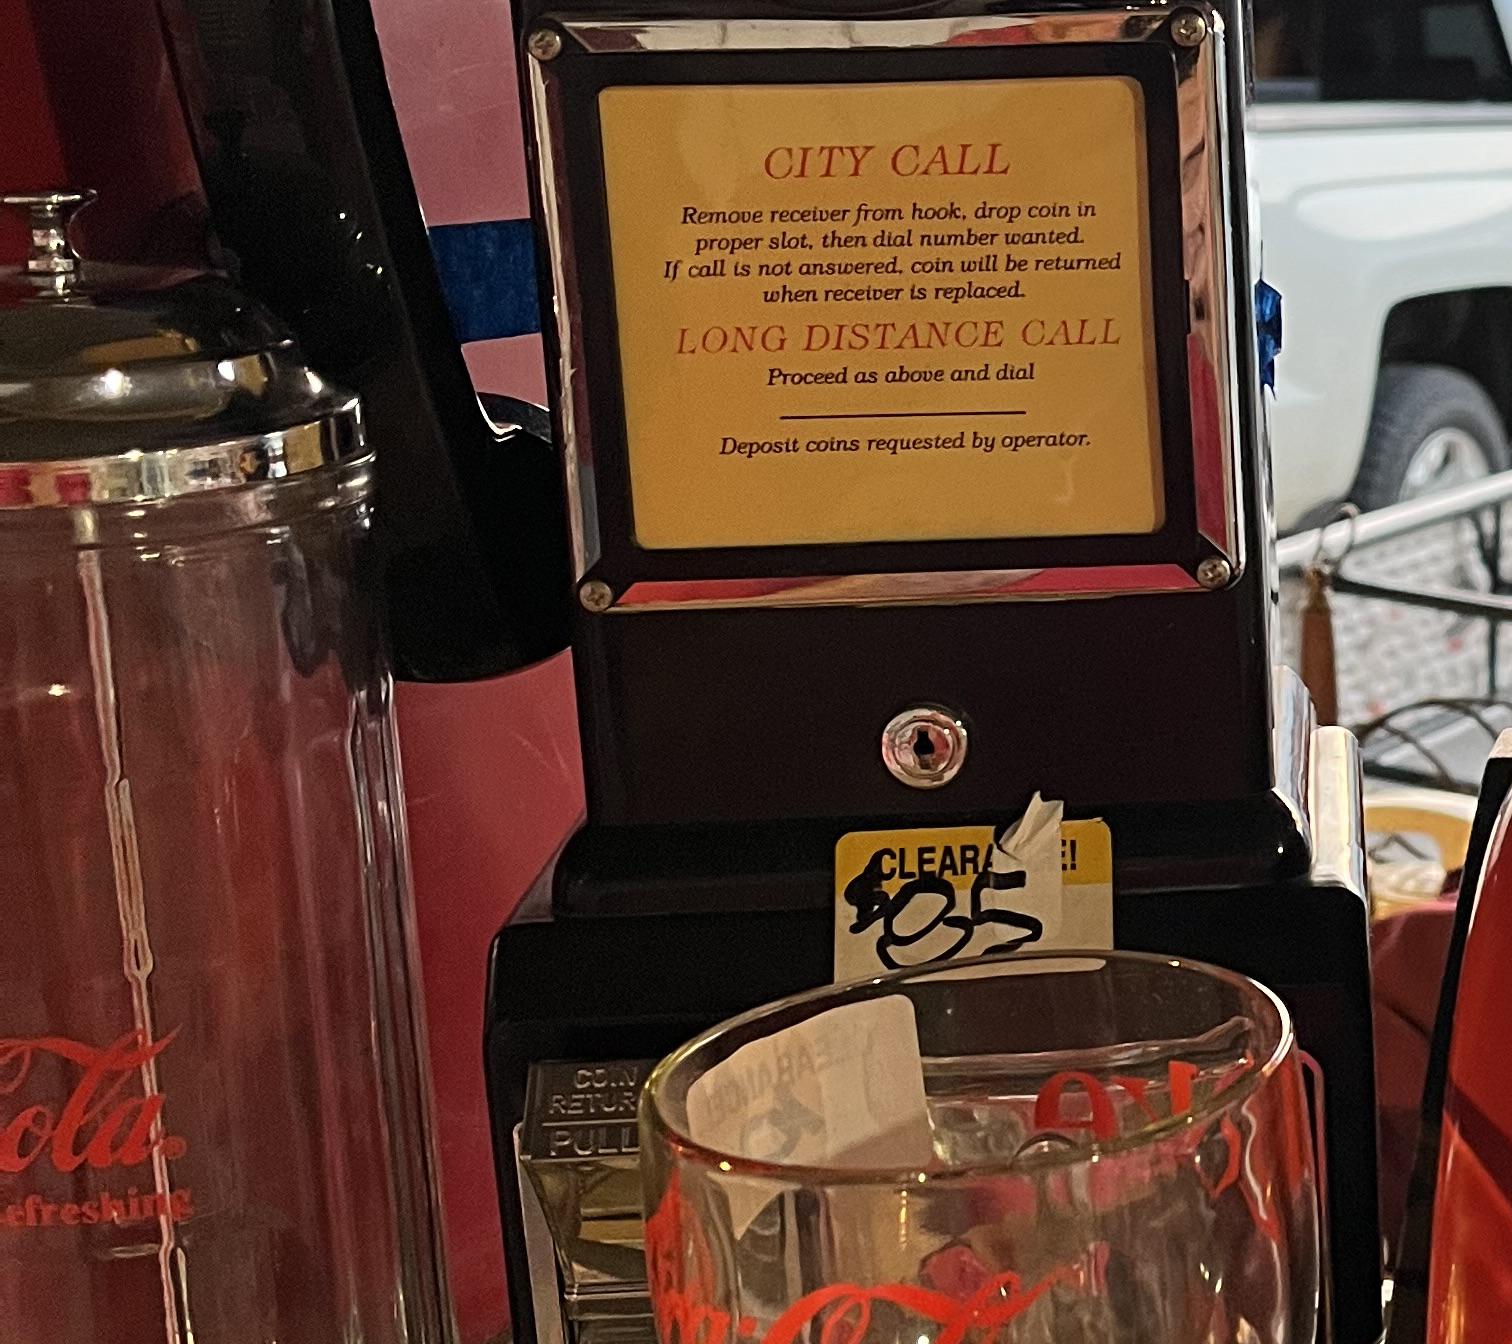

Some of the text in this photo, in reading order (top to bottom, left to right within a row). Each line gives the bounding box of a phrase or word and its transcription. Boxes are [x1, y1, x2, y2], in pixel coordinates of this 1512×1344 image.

[763, 142, 1011, 180] CITY CALL
[681, 200, 1097, 227] Remove receiver from hook, drop coin in
[695, 227, 1085, 255] proper slot, then dial number wanted.
[663, 253, 1121, 281] If call is not answered, coin will be returned
[762, 280, 1026, 305] when receiver is replaced.
[677, 318, 1121, 356] LONG DISTANCE CALL
[766, 362, 1034, 387] Proceed as above and dial
[719, 429, 1091, 457] Deposit coins requested by operator.
[574, 1067, 638, 1088] COIN
[0, 1024, 184, 1172] ola
[550, 1092, 639, 1114] RETUR
[550, 1127, 640, 1156] PULL
[0, 1187, 194, 1225] efreshing
